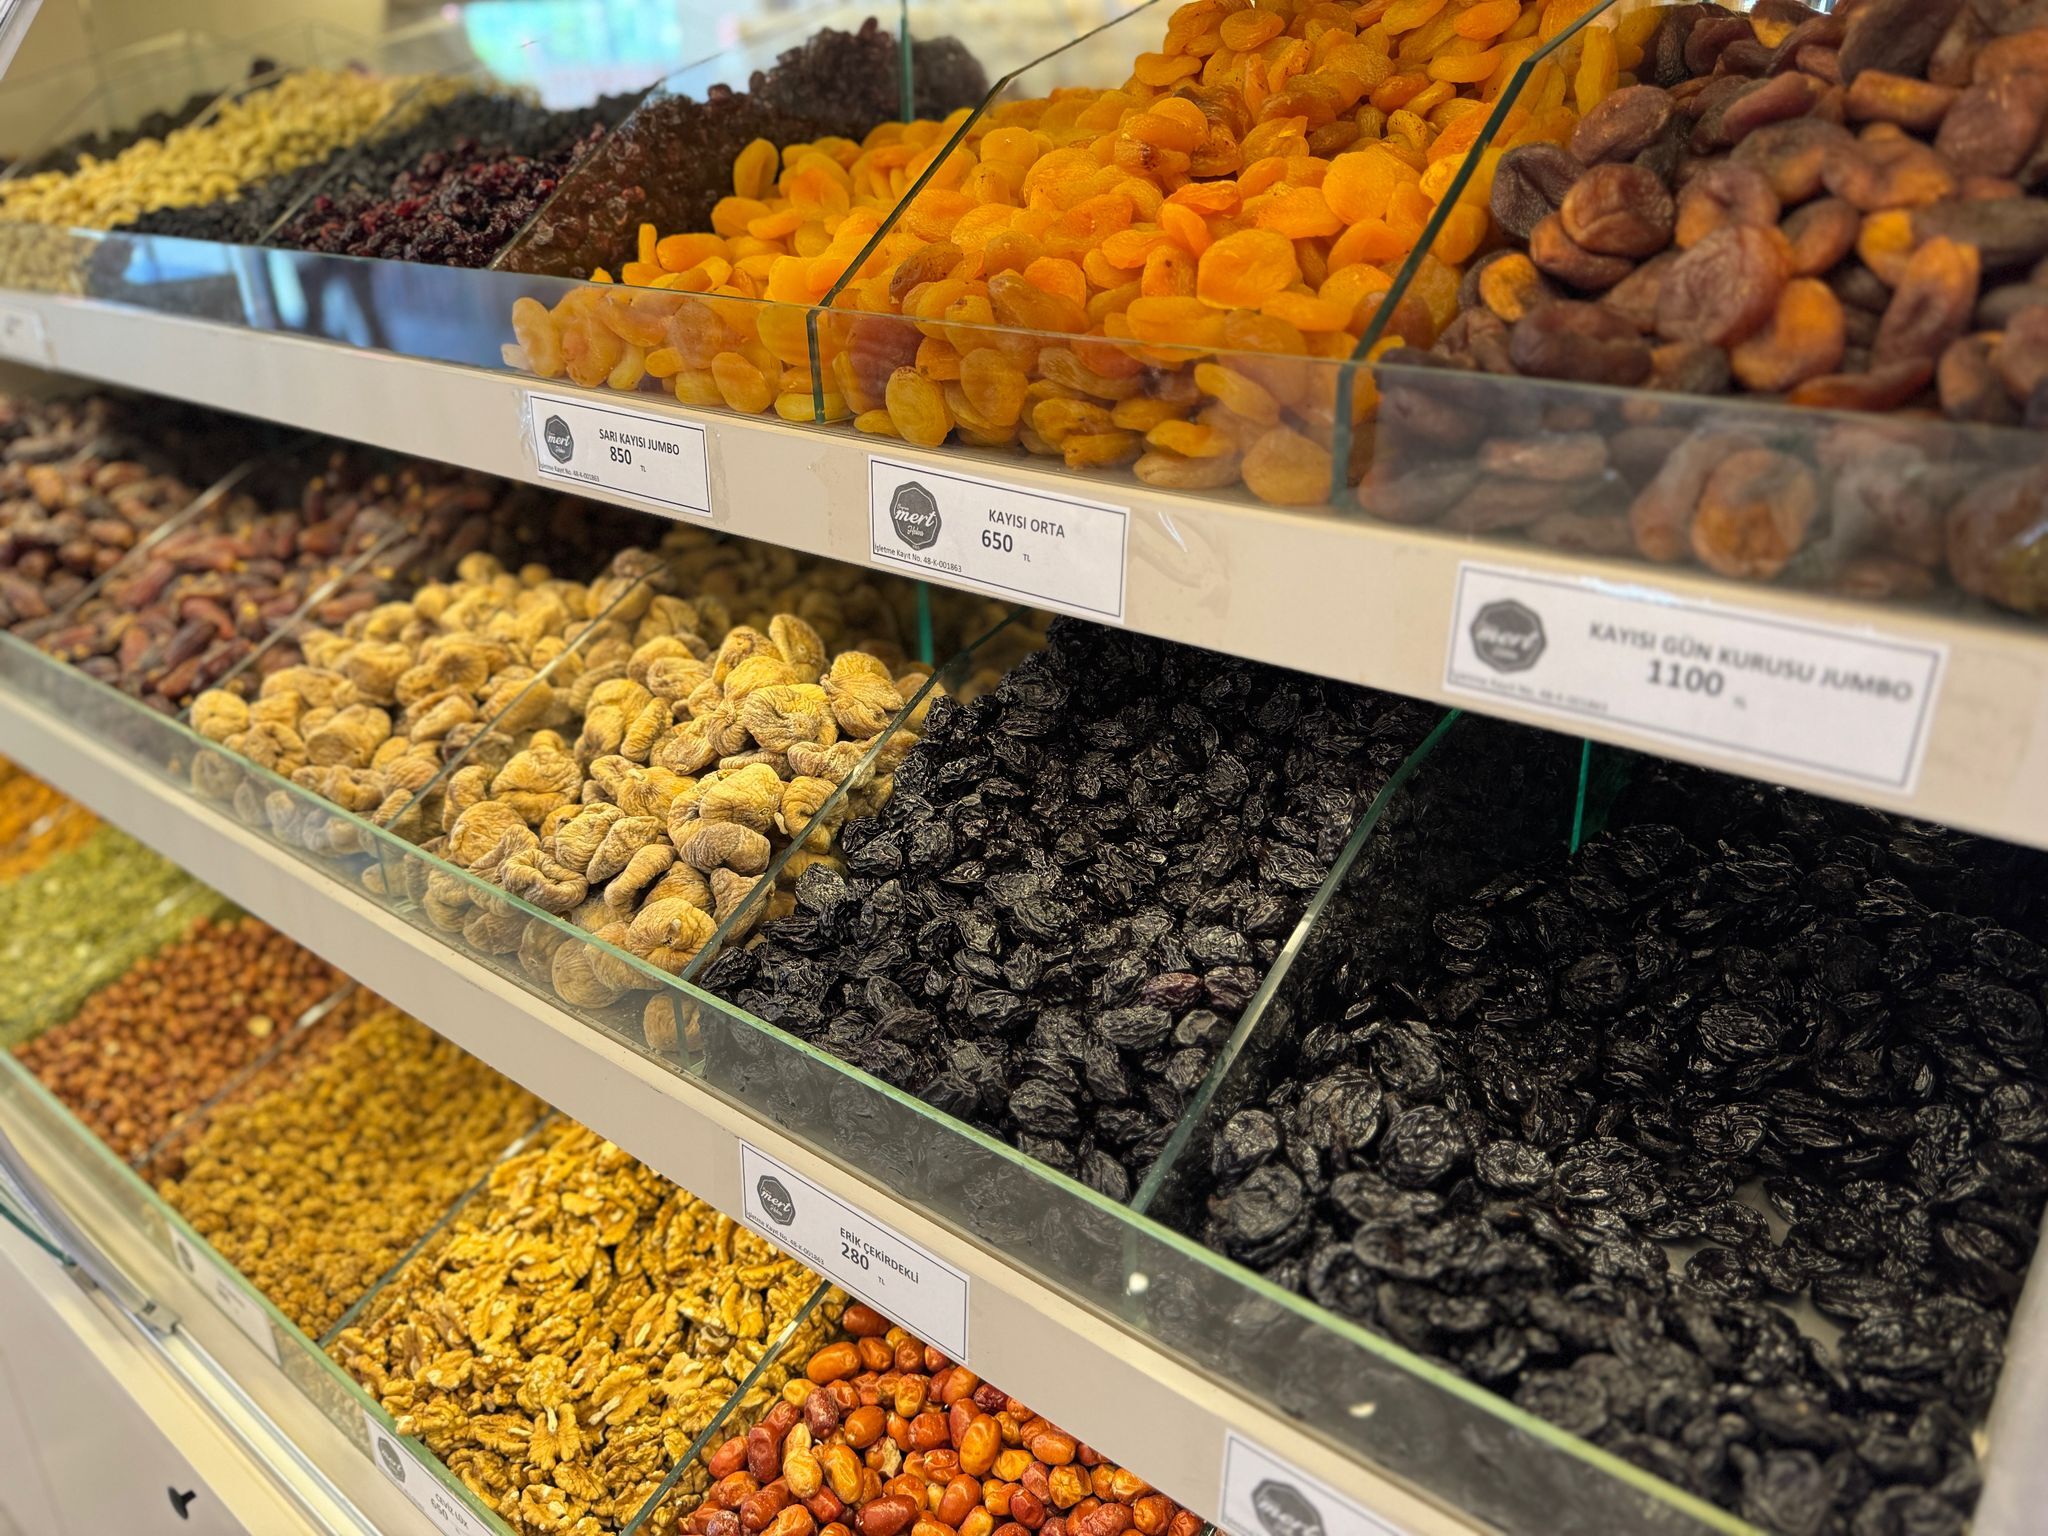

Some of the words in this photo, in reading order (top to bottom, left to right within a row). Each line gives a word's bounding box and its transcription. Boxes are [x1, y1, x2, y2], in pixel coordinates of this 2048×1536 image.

[599, 429, 617, 442] SARI
[620, 433, 646, 448] KAYISI
[648, 439, 680, 455] JUMBO
[610, 446, 632, 465] 850
[894, 509, 937, 528] mert
[988, 509, 1027, 530] KAYISI
[1030, 519, 1065, 538] ORTA
[981, 529, 1013, 553] 650
[1023, 553, 1031, 563] TL
[1588, 621, 1657, 652] KAYISI
[1662, 633, 1713, 663] GÜN
[1718, 647, 1816, 684] KURUSU
[1820, 669, 1914, 703] JUMBO
[1646, 659, 1725, 698] 1100
[760, 1191, 791, 1212] mert
[840, 1226, 861, 1247] ERİK
[863, 1242, 919, 1284] ÇEKİRDEKLİ
[841, 1242, 869, 1271] 280
